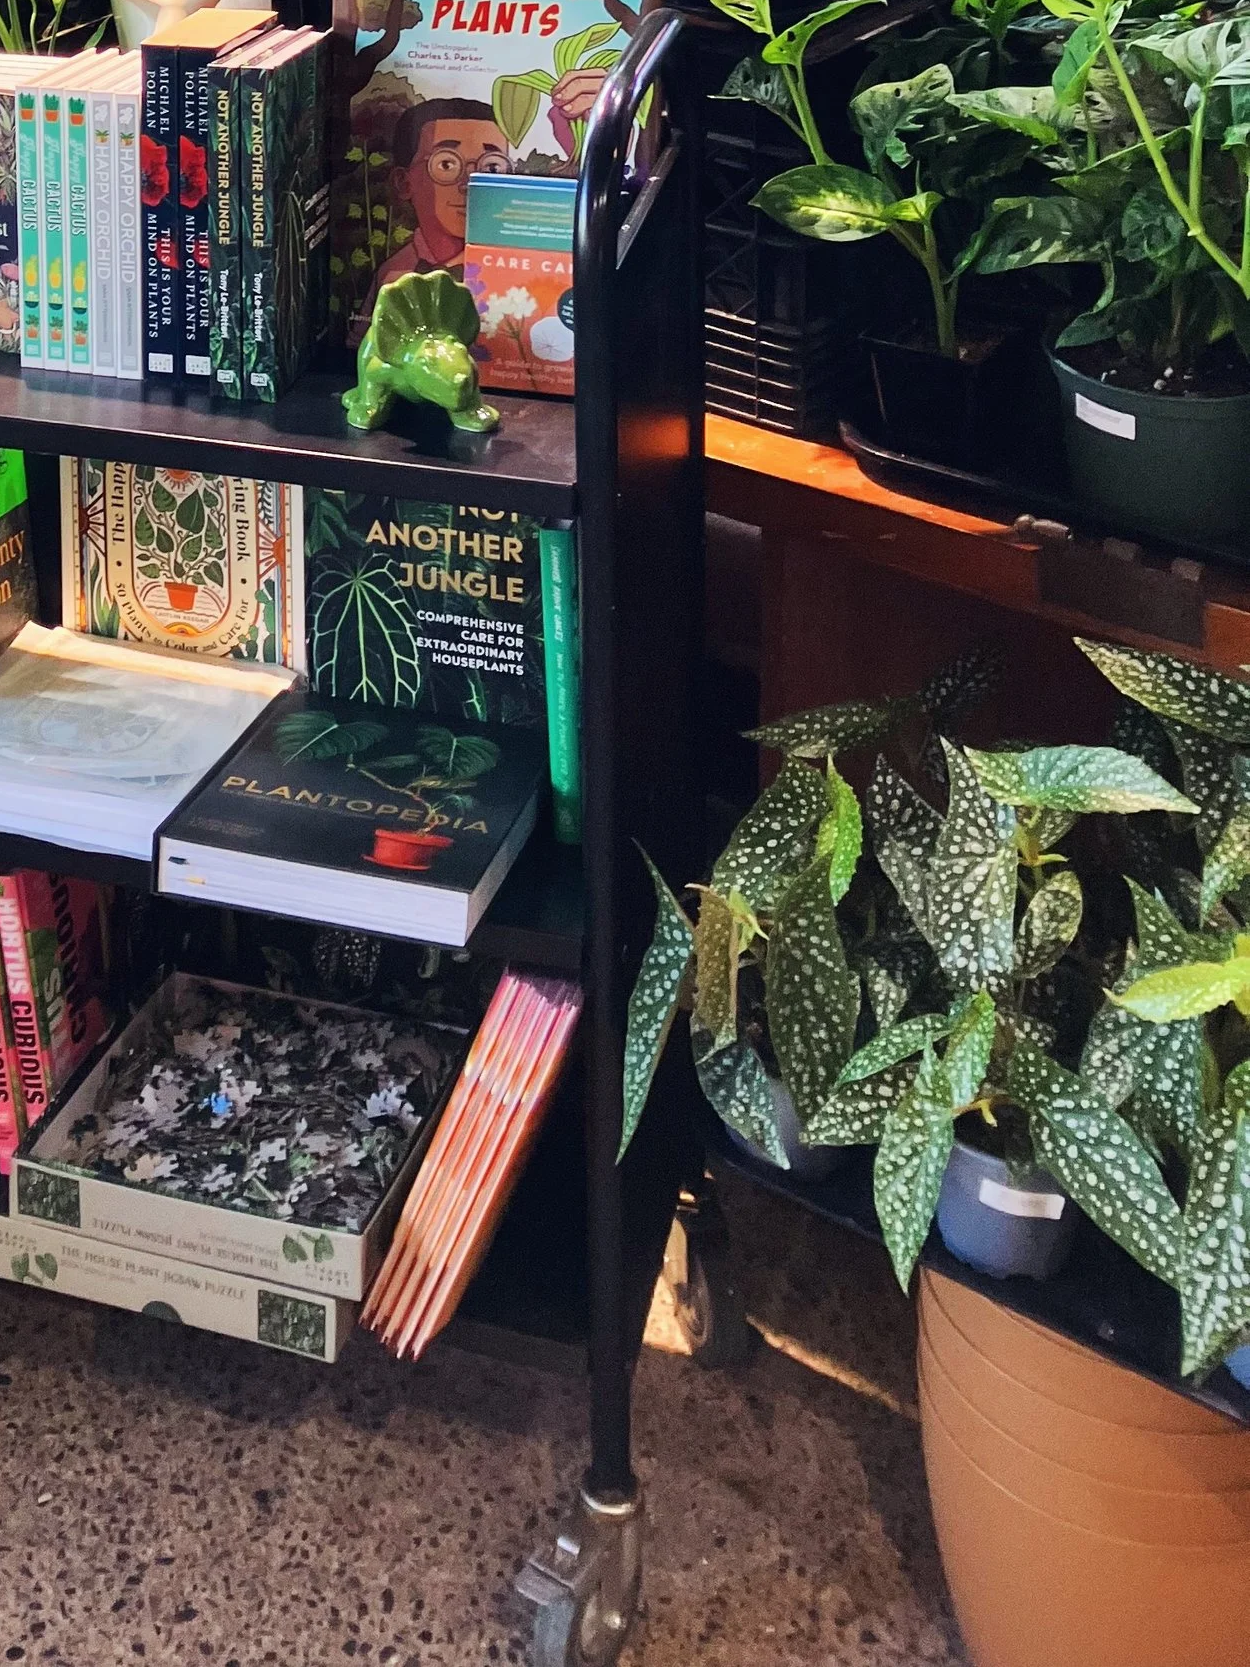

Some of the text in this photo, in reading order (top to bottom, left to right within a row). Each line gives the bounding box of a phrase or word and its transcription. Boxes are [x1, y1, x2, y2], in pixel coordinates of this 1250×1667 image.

[408, 51, 441, 60] Charles
[454, 53, 484, 62] Parker
[146, 70, 156, 129] POLLAN
[159, 66, 170, 134] MICHAEL
[185, 71, 195, 130] POLLAN
[198, 67, 208, 135] MICHAEL
[94, 145, 110, 204] HAPPY
[118, 149, 135, 207] HAPPY
[217, 90, 230, 245] NOT ANOTHER JUNGLE
[251, 92, 265, 248] NOT ANOTHER JUNGLE
[21, 179, 37, 231] CACTUS
[46, 180, 62, 232] CACTUS
[70, 184, 87, 236] CACTUS
[95, 209, 111, 280] ORCHID
[120, 211, 136, 283] ORCHID
[483, 255, 573, 274] CARE CA
[147, 213, 158, 338] MIND ON PLANTS
[160, 228, 172, 325] THIS IS YOUR
[185, 214, 196, 340] MIND ON PLANTS
[198, 230, 209, 328] THIS IS YOUR
[219, 269, 229, 292] Tony
[253, 272, 264, 342] Tony Le-Britton
[111, 461, 127, 543] The Happ
[237, 519, 251, 562] Book
[365, 520, 523, 564] ANOTHER
[399, 563, 524, 604] JUNGLE
[116, 583, 126, 597] 50
[122, 601, 152, 638] Plants
[202, 641, 217, 652] and
[221, 622, 242, 645] Care
[236, 599, 249, 620] For
[416, 610, 524, 635] COMPREHENSIVE
[461, 630, 524, 649] CARE FOR
[416, 636, 524, 661] EXTRAORDINARY
[432, 652, 524, 676] HOUSEPLANTS
[222, 776, 488, 834] PLANTOPEDIA
[11, 1000, 44, 1105] CURIOUS
[61, 1245, 80, 1259] THE
[85, 1250, 121, 1270] HOUSE
[125, 1260, 160, 1278] PLANT
[163, 1269, 200, 1289] JIGSAW
[205, 1279, 246, 1301] PUZZLE
